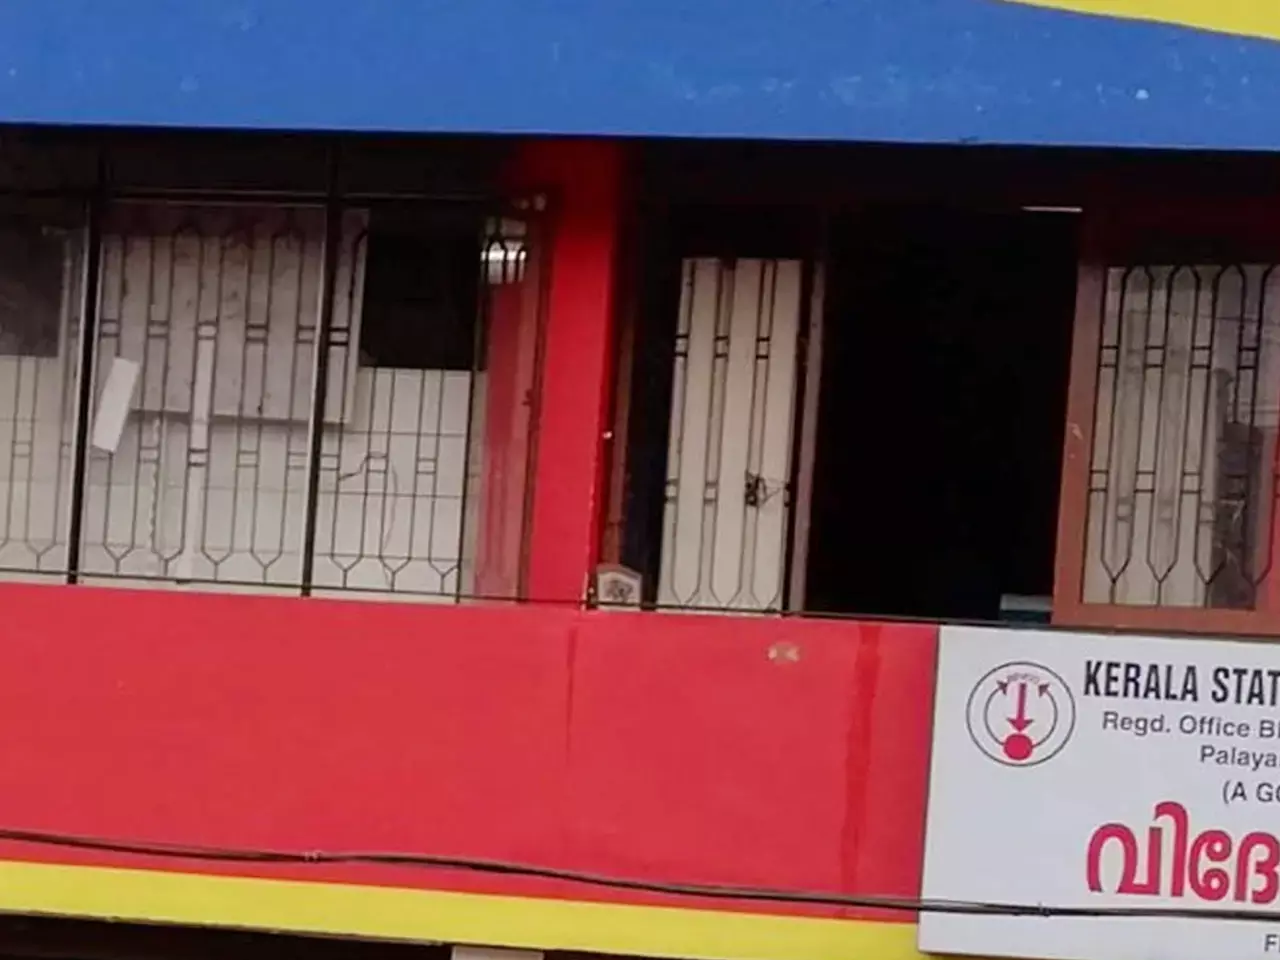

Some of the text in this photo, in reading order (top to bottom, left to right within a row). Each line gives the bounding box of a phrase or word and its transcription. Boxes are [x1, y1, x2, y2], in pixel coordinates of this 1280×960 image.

[1084, 660, 1199, 702] KERALA
[1102, 711, 1171, 736] Regd.
[1179, 715, 1250, 738] Office
[1222, 781, 1248, 806] (A
